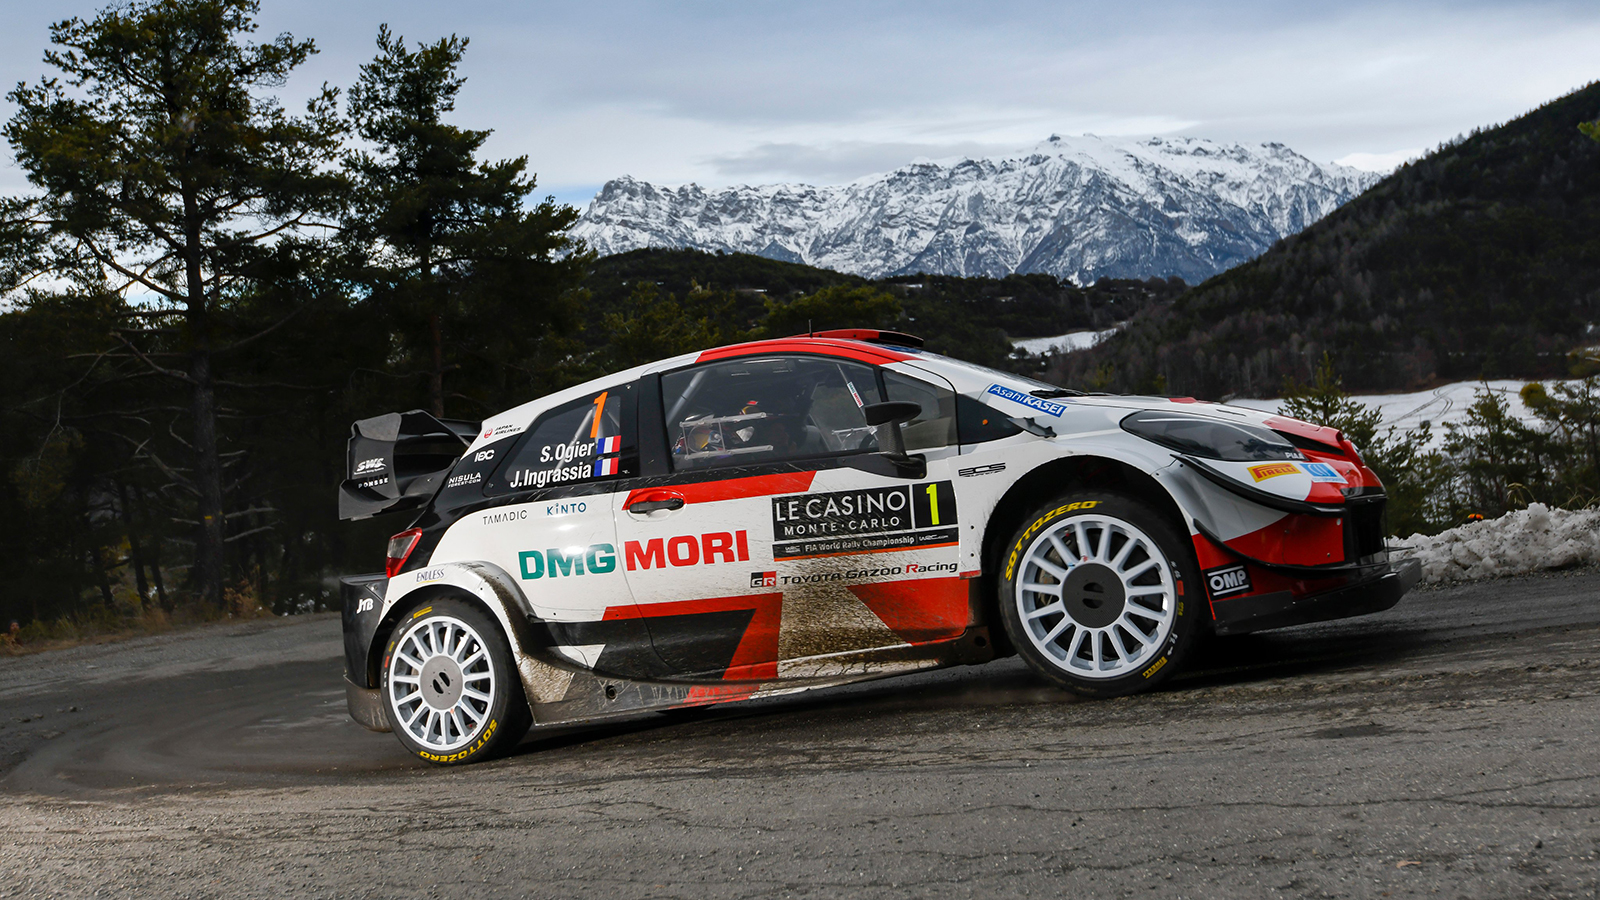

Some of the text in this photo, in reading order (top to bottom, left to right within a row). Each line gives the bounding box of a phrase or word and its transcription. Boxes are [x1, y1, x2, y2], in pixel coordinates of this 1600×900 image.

[590, 391, 608, 438] 1
[540, 441, 595, 463] S.Ogier
[358, 477, 389, 489] PONSSE
[448, 472, 481, 485] NISULA
[510, 462, 592, 488] J.Ingrassia
[1252, 464, 1297, 479] PIRELLI
[775, 490, 906, 522] LE CASINO
[926, 483, 940, 526] 1
[483, 509, 528, 526] TAMADIC
[805, 545, 818, 553] FIA
[818, 541, 841, 552] World
[842, 541, 861, 551] Rally
[862, 535, 915, 548] Championship
[1004, 500, 1099, 581] SOTTOZERO
[518, 529, 750, 580] DMG MORI
[416, 568, 445, 583] ENDLESS
[752, 562, 959, 586] GR TOYOTA GAZOO Racing
[1209, 569, 1248, 592] OMP
[419, 719, 497, 762] SOTTOZERO
